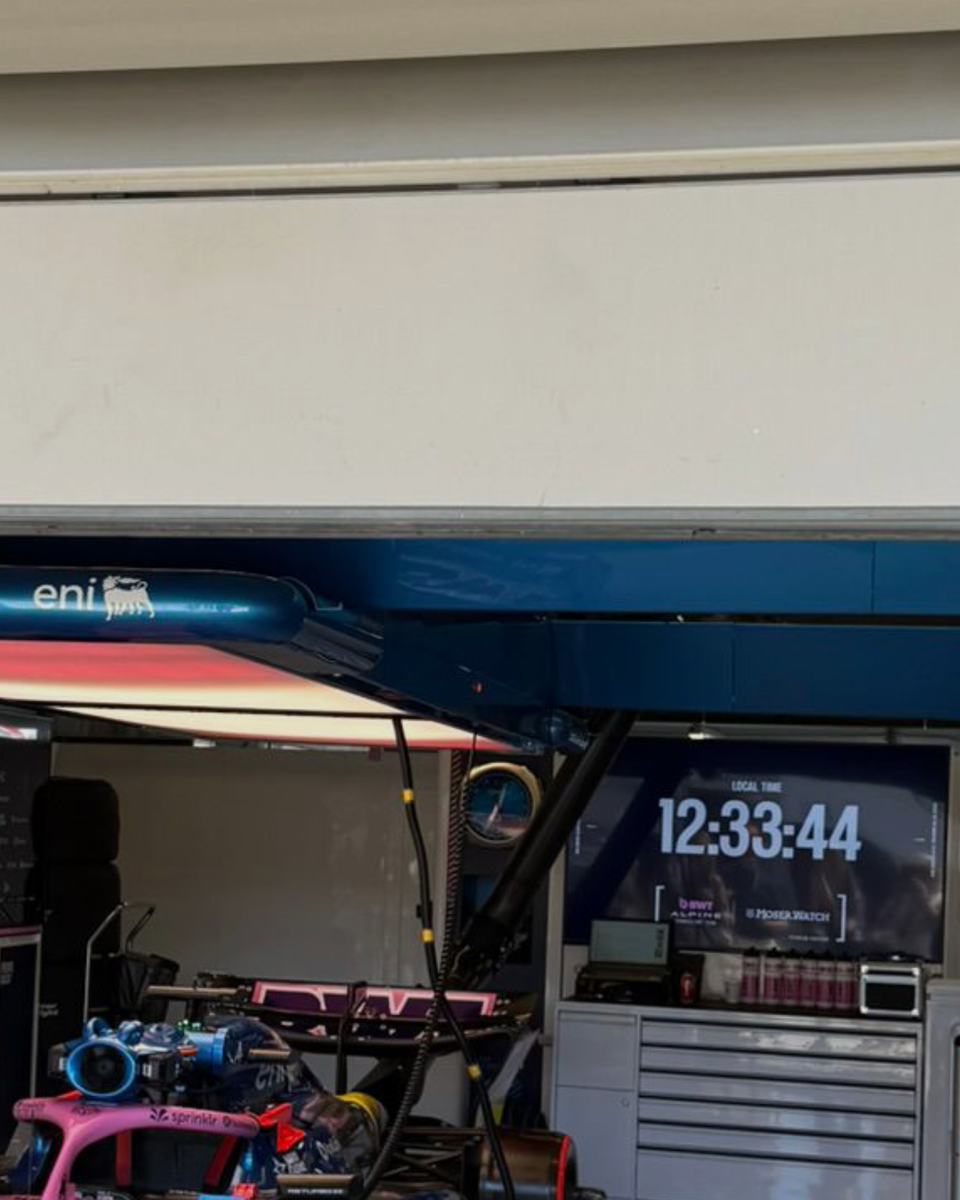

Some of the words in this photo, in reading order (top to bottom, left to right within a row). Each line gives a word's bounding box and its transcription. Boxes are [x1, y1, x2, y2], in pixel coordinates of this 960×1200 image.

[33, 577, 96, 611] eni
[731, 781, 758, 792] LOCAL
[761, 782, 782, 793] TIME
[658, 797, 862, 862] 12:33:44
